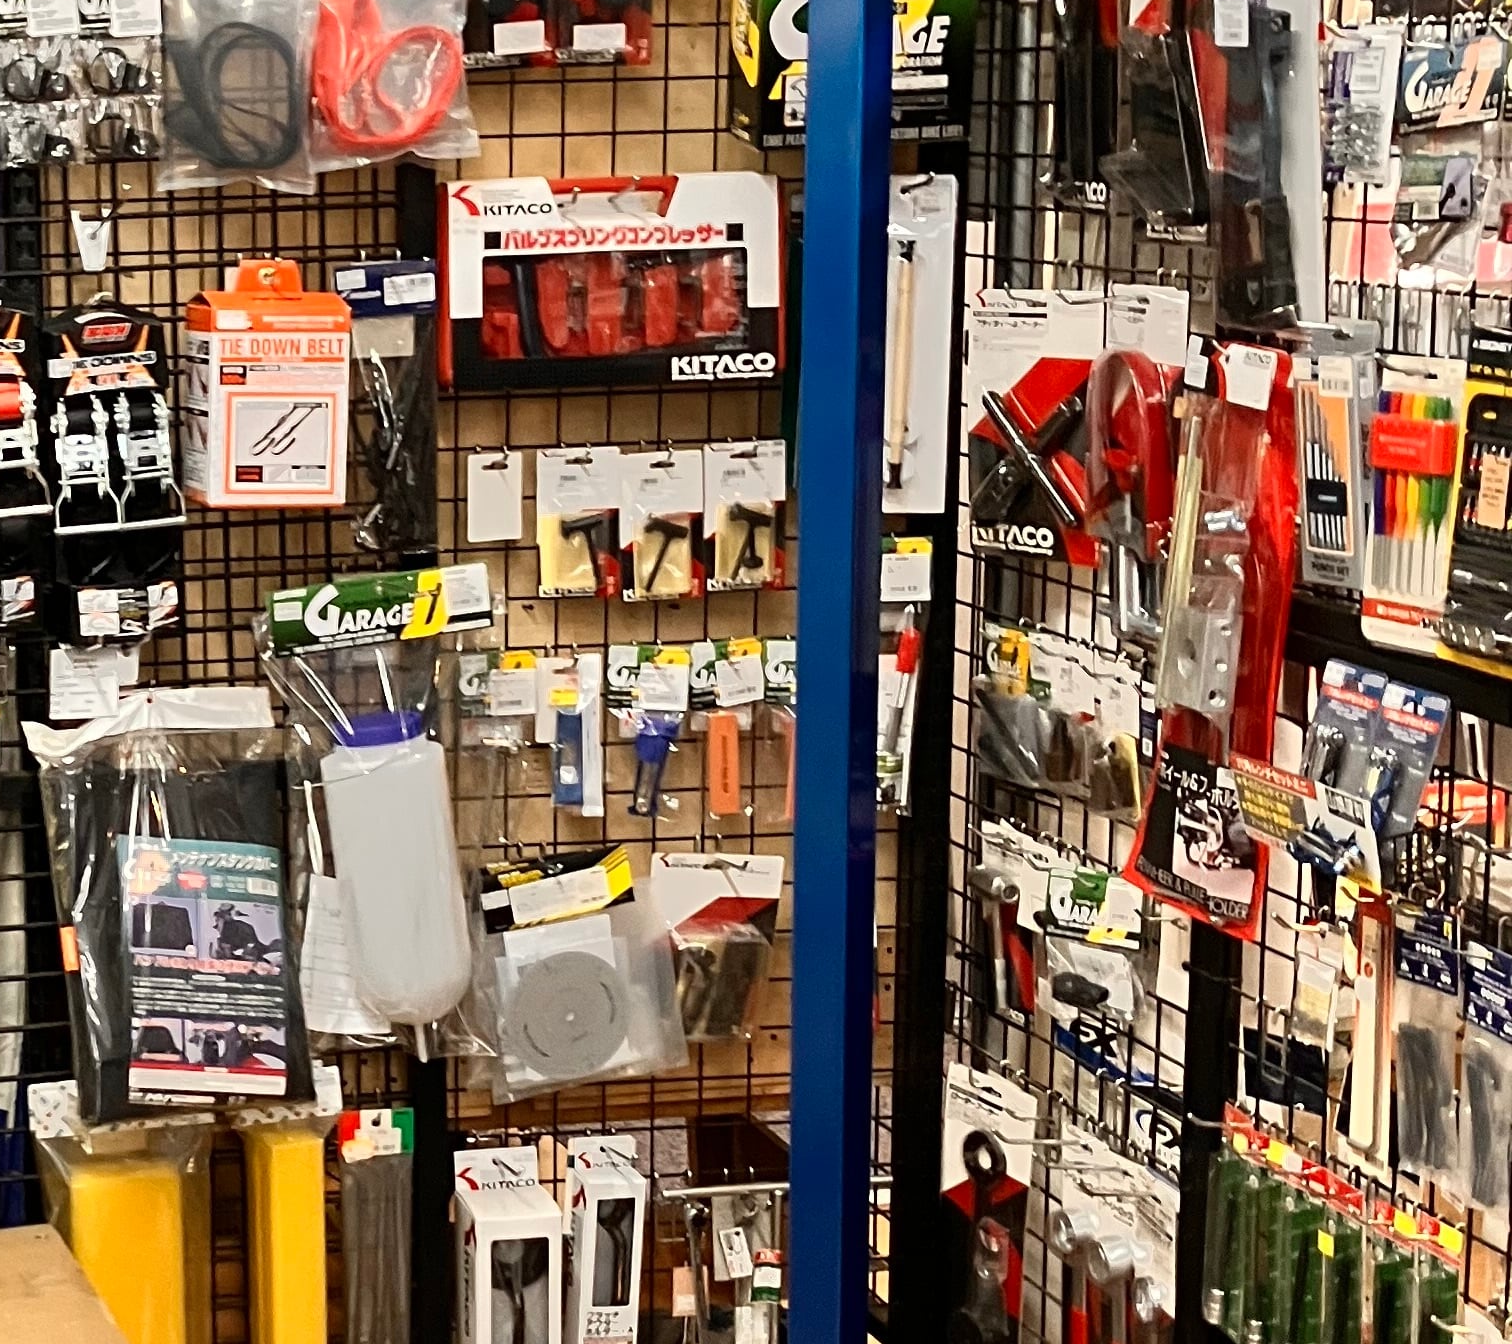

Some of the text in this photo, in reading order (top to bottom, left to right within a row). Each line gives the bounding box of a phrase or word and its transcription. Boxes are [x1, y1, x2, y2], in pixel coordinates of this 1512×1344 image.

[484, 203, 553, 216] KITACO
[504, 224, 724, 250] バルブスプリングコンプレッサー
[220, 337, 345, 356] TIE DOWN BELT
[671, 351, 776, 381] KITACO
[304, 583, 415, 637] GARAGE
